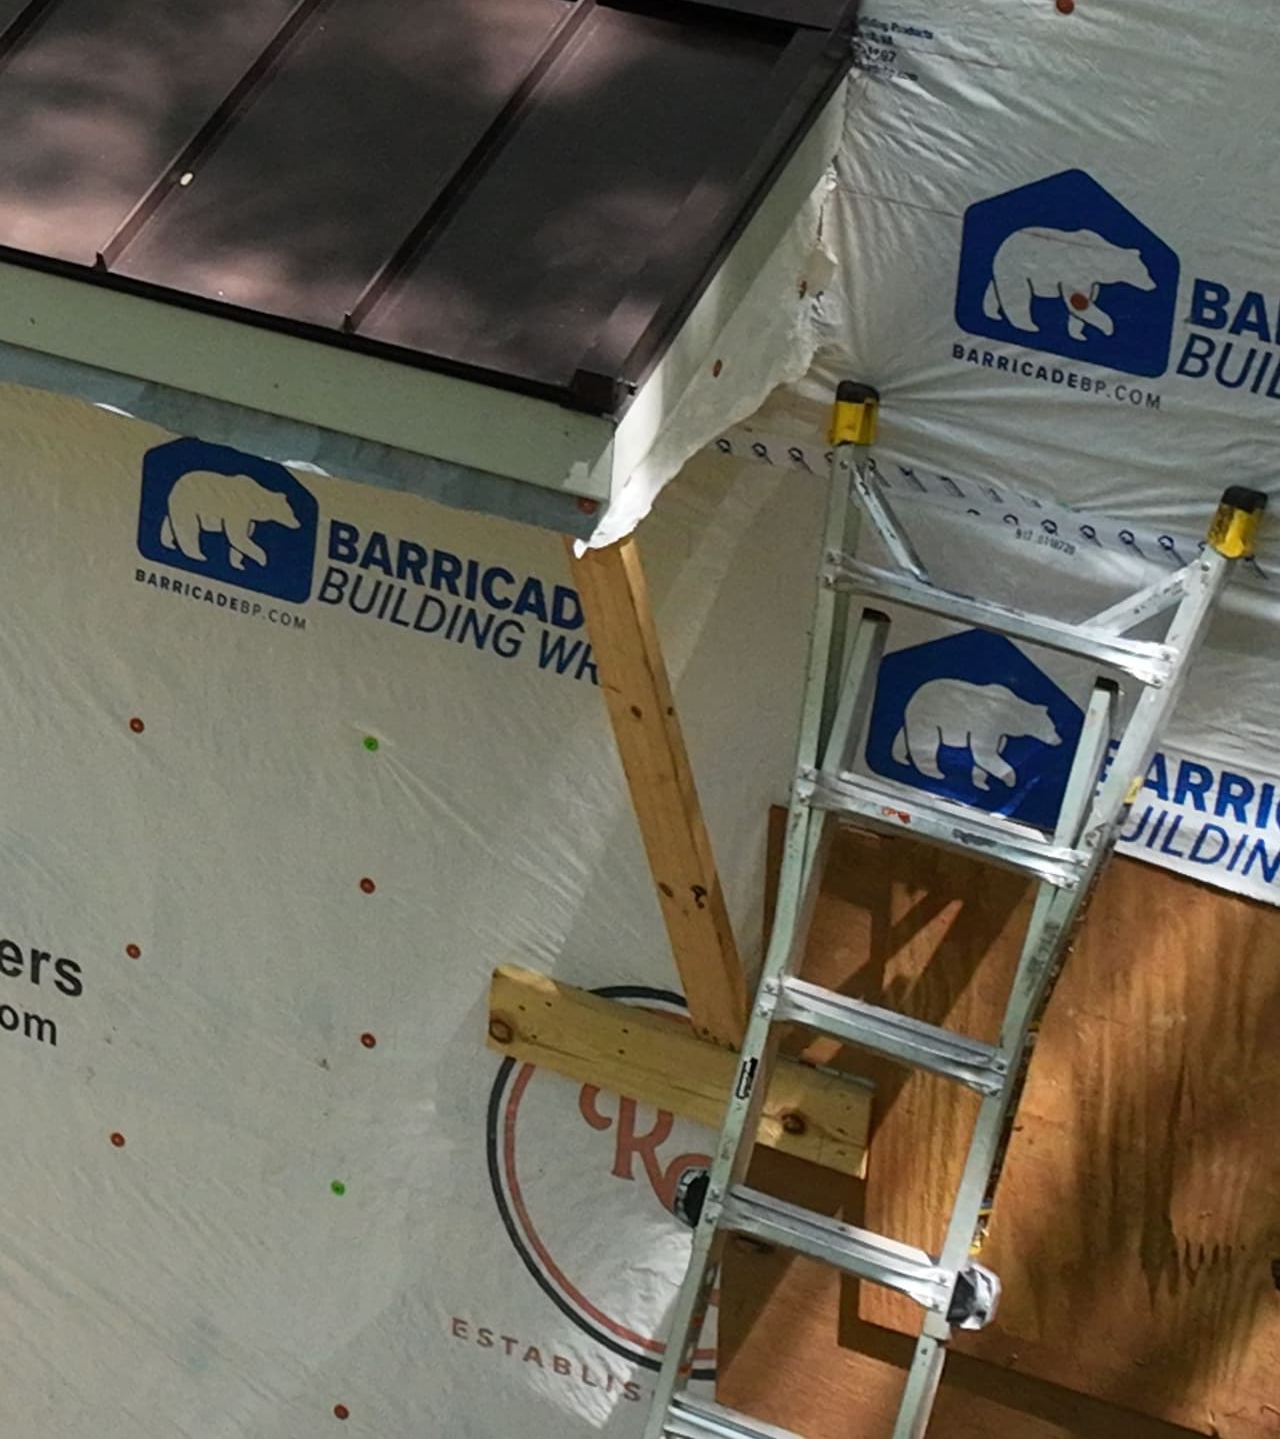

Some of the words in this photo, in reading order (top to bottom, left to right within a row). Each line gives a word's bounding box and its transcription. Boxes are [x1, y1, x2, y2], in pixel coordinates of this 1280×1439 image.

[952, 343, 1161, 411] BARRICADEBP.COM
[134, 568, 308, 631] BARRICADEBP.COM
[317, 564, 523, 659] BUILDING
